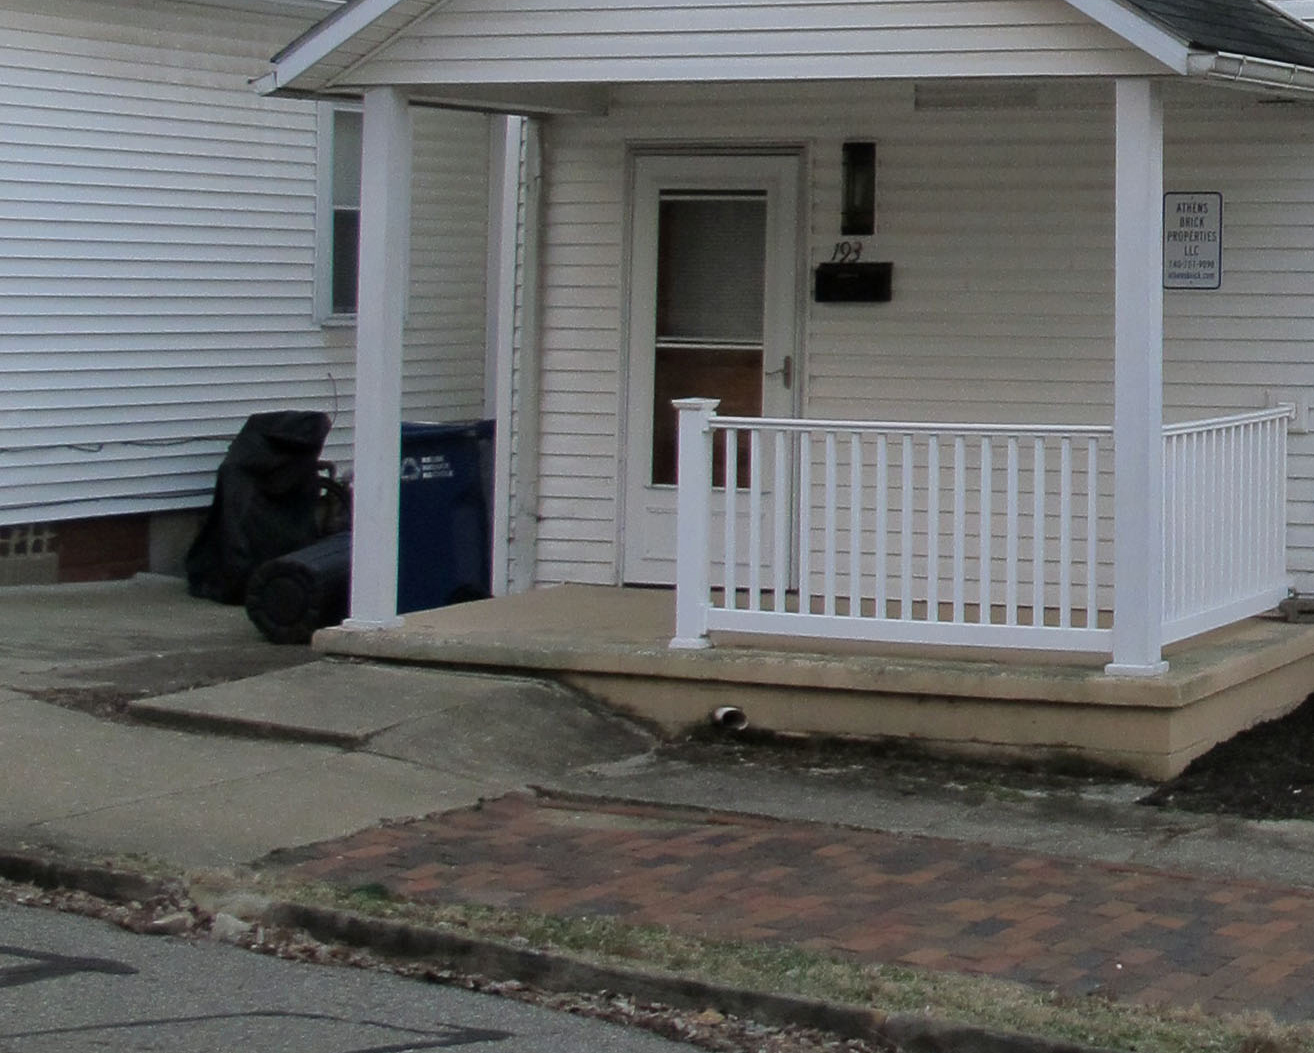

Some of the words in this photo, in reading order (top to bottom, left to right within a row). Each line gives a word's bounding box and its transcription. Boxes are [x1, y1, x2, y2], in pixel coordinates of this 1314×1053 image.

[1176, 202, 1208, 214] ATHENS
[1180, 216, 1205, 228] BRICK
[1167, 230, 1217, 242] PROPERTIES
[832, 241, 863, 263] 193
[1184, 245, 1200, 256] LLC
